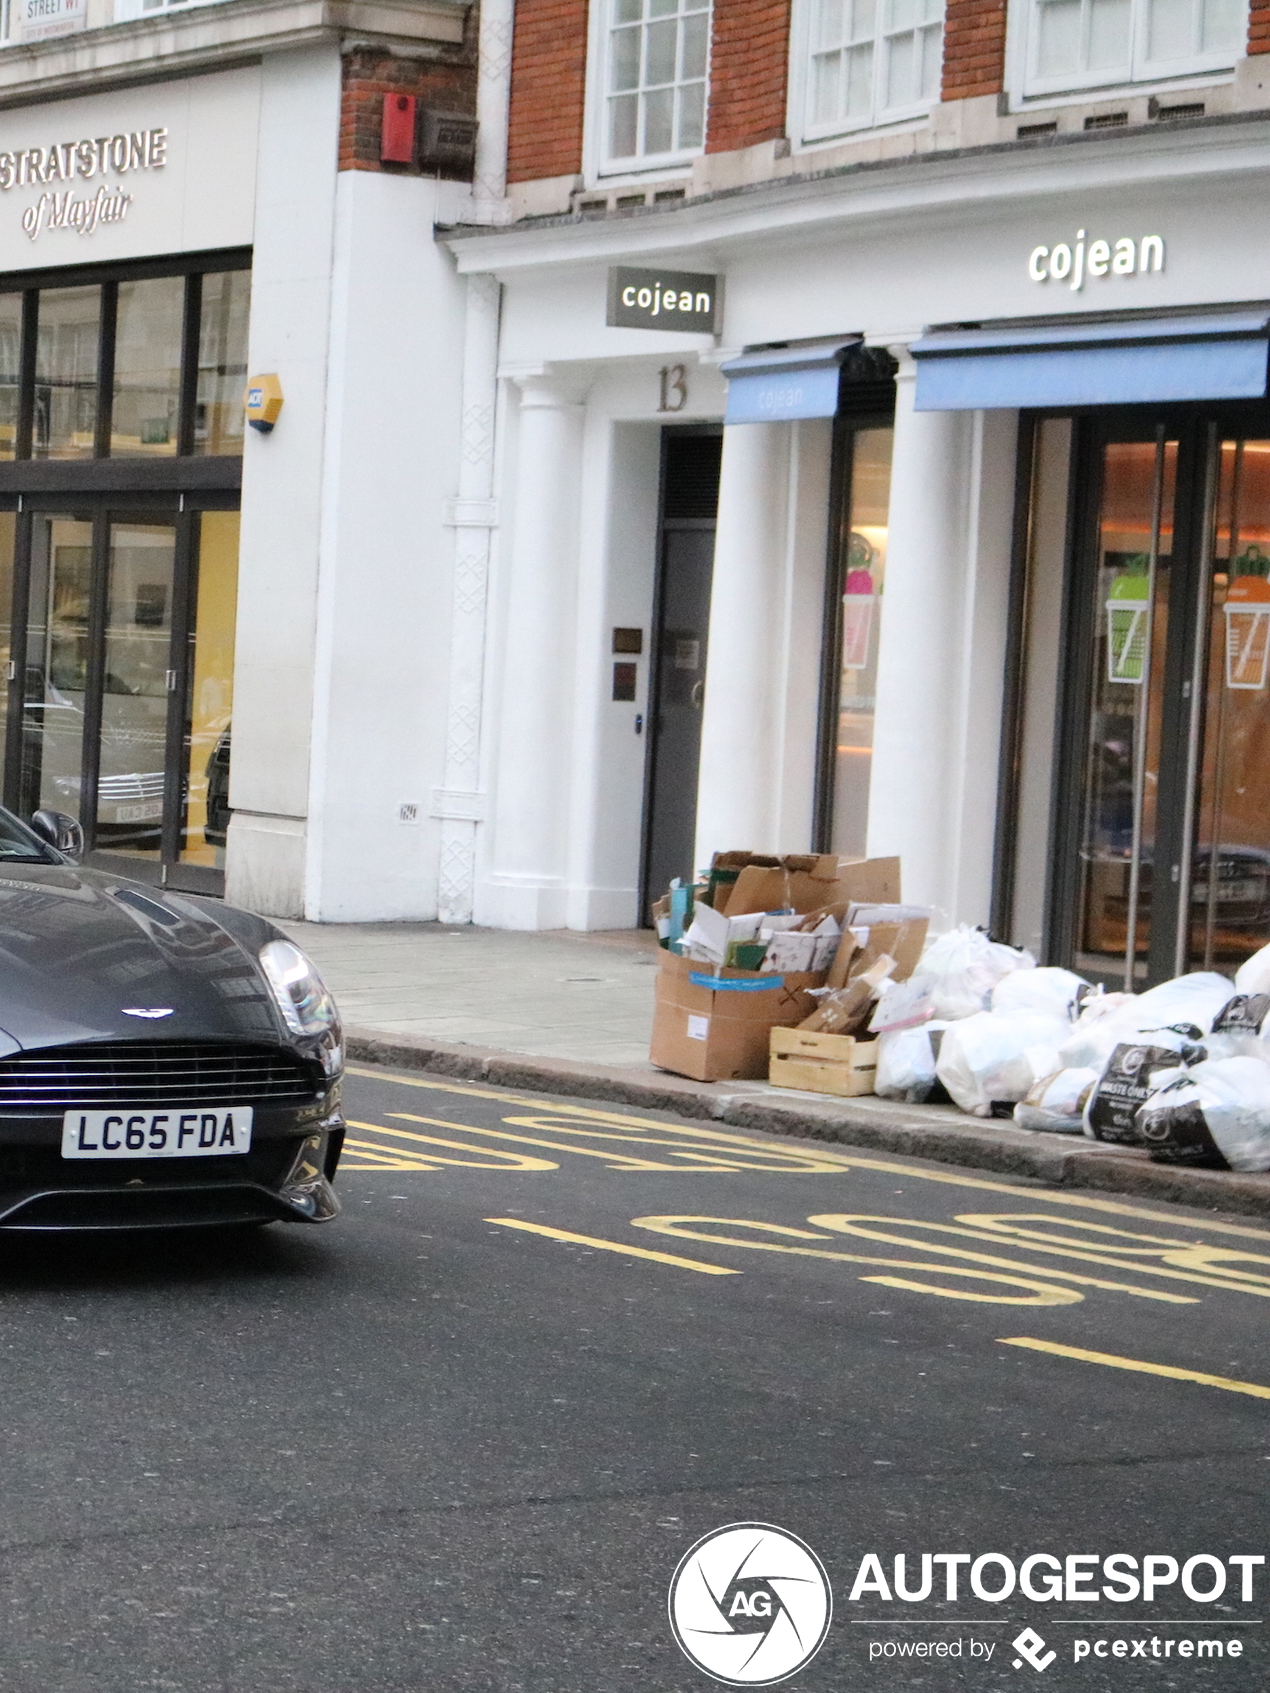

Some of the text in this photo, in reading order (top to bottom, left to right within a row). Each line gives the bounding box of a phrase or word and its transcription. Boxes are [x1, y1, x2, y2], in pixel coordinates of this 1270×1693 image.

[27, 0, 61, 18] STREET
[22, 184, 134, 241] of Mayfair
[1028, 229, 1167, 293] cojean
[622, 282, 711, 316] cojean
[657, 363, 688, 413] 13
[759, 387, 804, 416] cojean
[1099, 1081, 1126, 1096] WASTE
[78, 1113, 235, 1151] LC65 FDA
